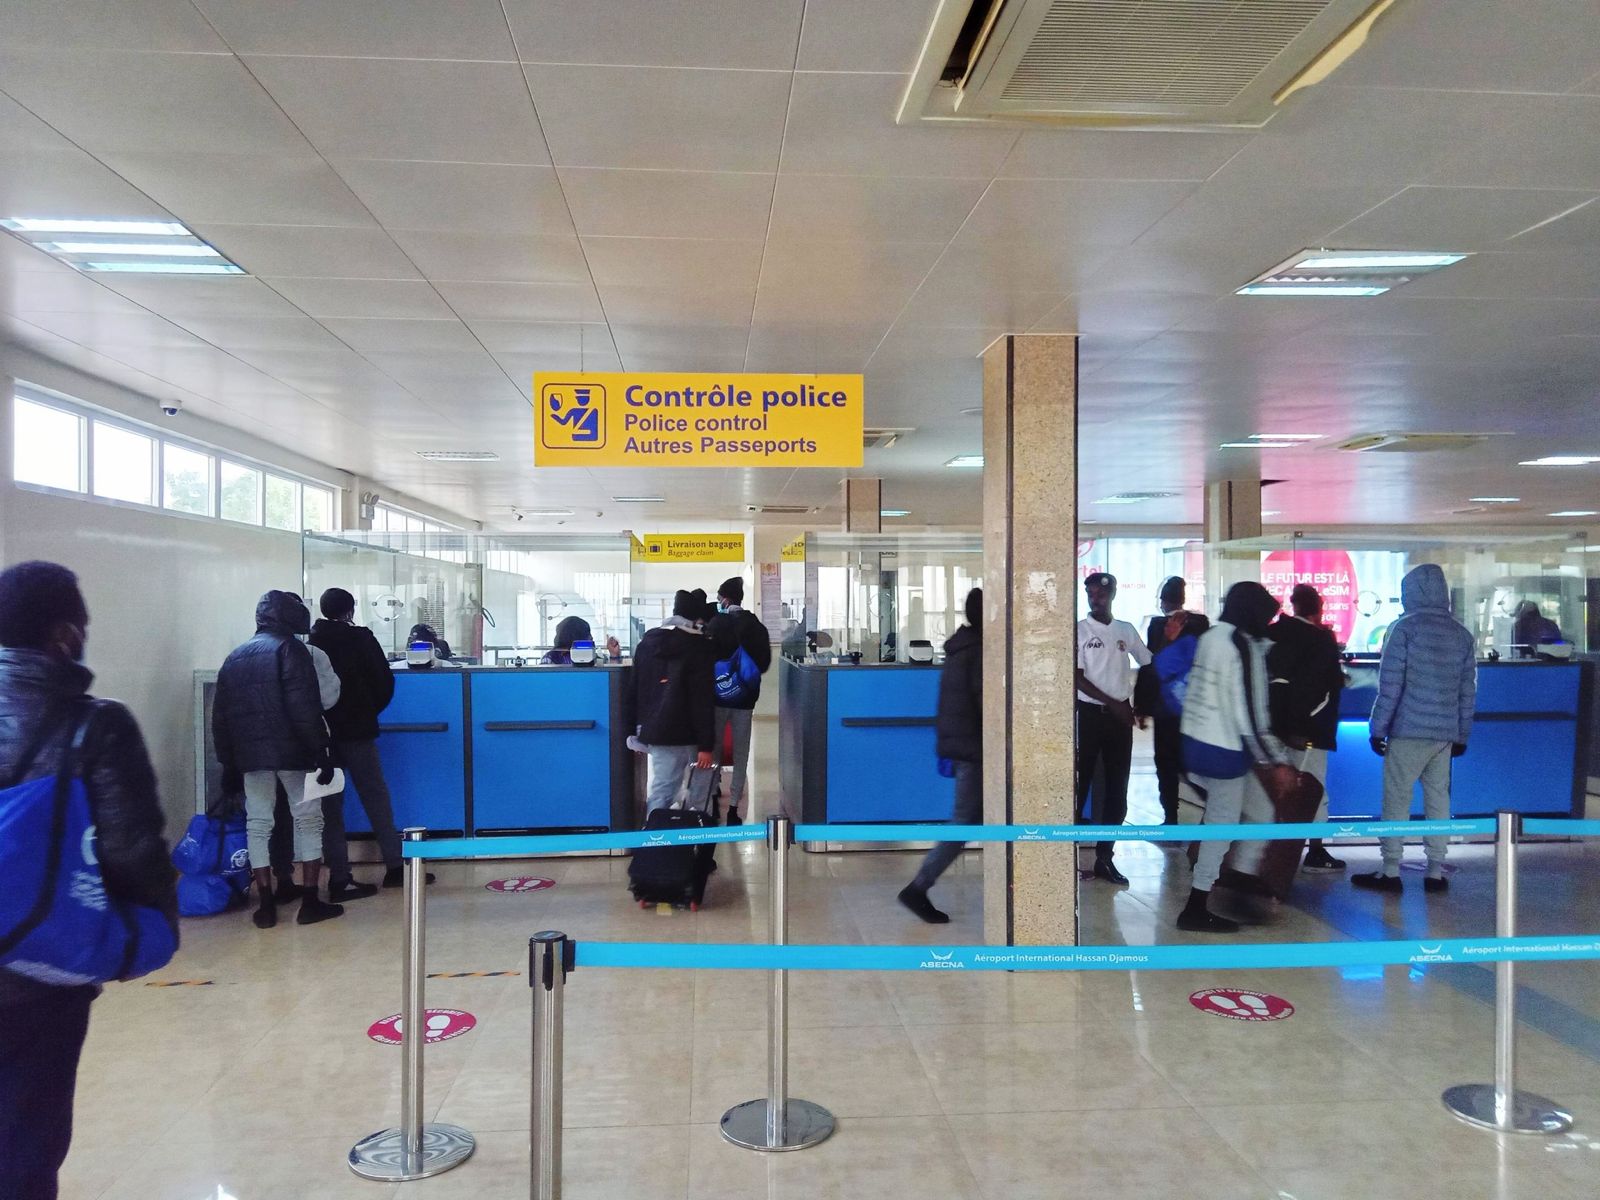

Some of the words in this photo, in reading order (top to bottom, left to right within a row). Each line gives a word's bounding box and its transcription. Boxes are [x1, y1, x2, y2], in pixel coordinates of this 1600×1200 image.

[625, 384, 752, 407] Contrôle
[762, 384, 847, 412] police
[625, 414, 688, 432] Police
[694, 413, 768, 431] control
[624, 437, 693, 453] Autres
[700, 437, 817, 456] Passeports
[667, 540, 706, 548] Livraison
[708, 540, 742, 550] bagages
[667, 550, 694, 558] Baggage
[1261, 572, 1276, 583] LE
[1276, 572, 1313, 583] FUTUR
[1314, 572, 1335, 583] EST
[1335, 570, 1350, 583] LÀ
[1322, 586, 1349, 597] eSIM
[1462, 946, 1501, 955] Aéroport
[1503, 944, 1560, 953] International
[974, 953, 1015, 963] Aéroport
[1016, 953, 1074, 962] International
[1075, 953, 1108, 962] Hassan
[1109, 953, 1149, 964] Djamous
[1409, 954, 1453, 962] ASECNA
